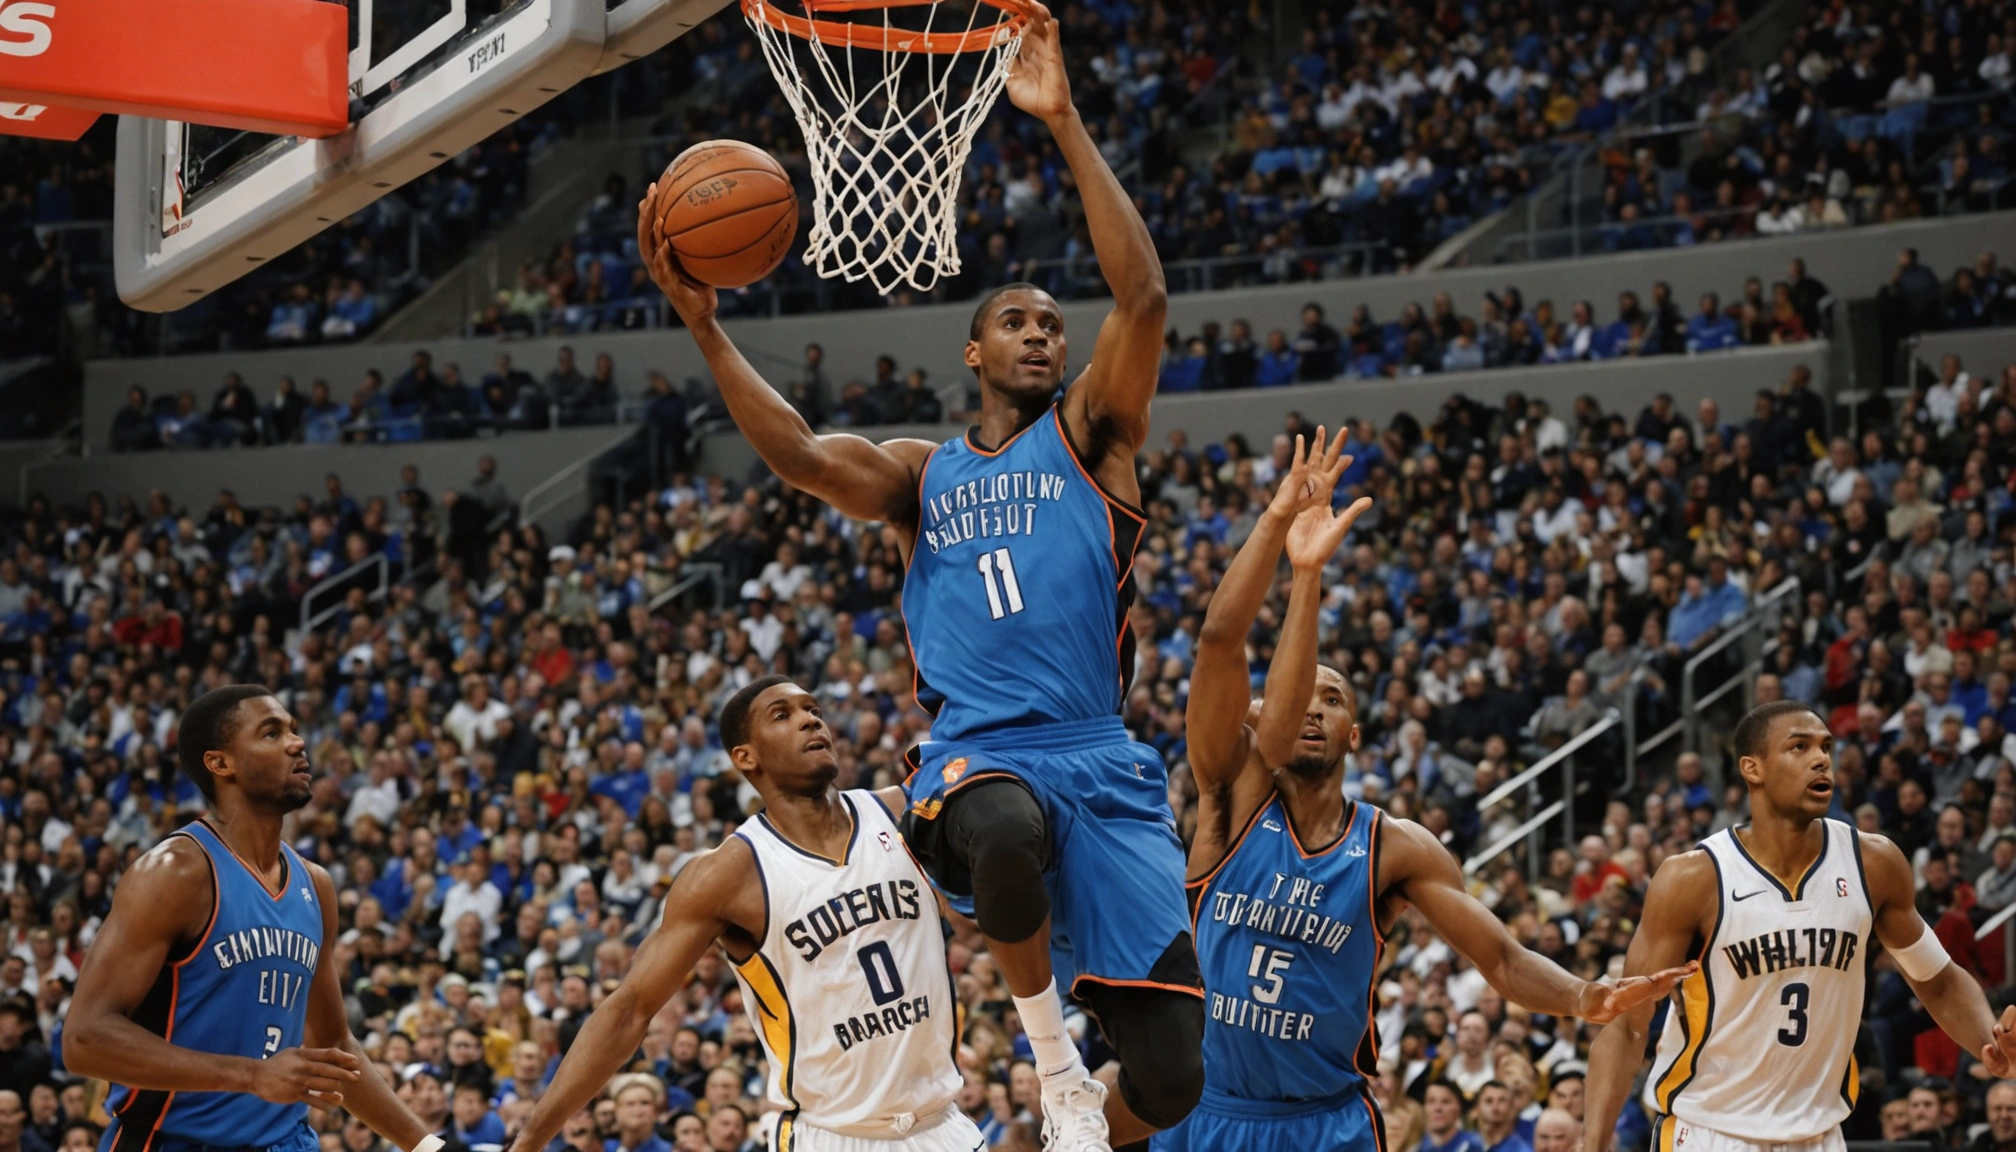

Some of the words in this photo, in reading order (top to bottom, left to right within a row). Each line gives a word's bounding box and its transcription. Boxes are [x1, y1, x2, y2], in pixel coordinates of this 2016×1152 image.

[0, 0, 56, 57] S
[977, 547, 1025, 620] 11
[1248, 944, 1295, 1004] 15
[1777, 982, 1810, 1047] 3
